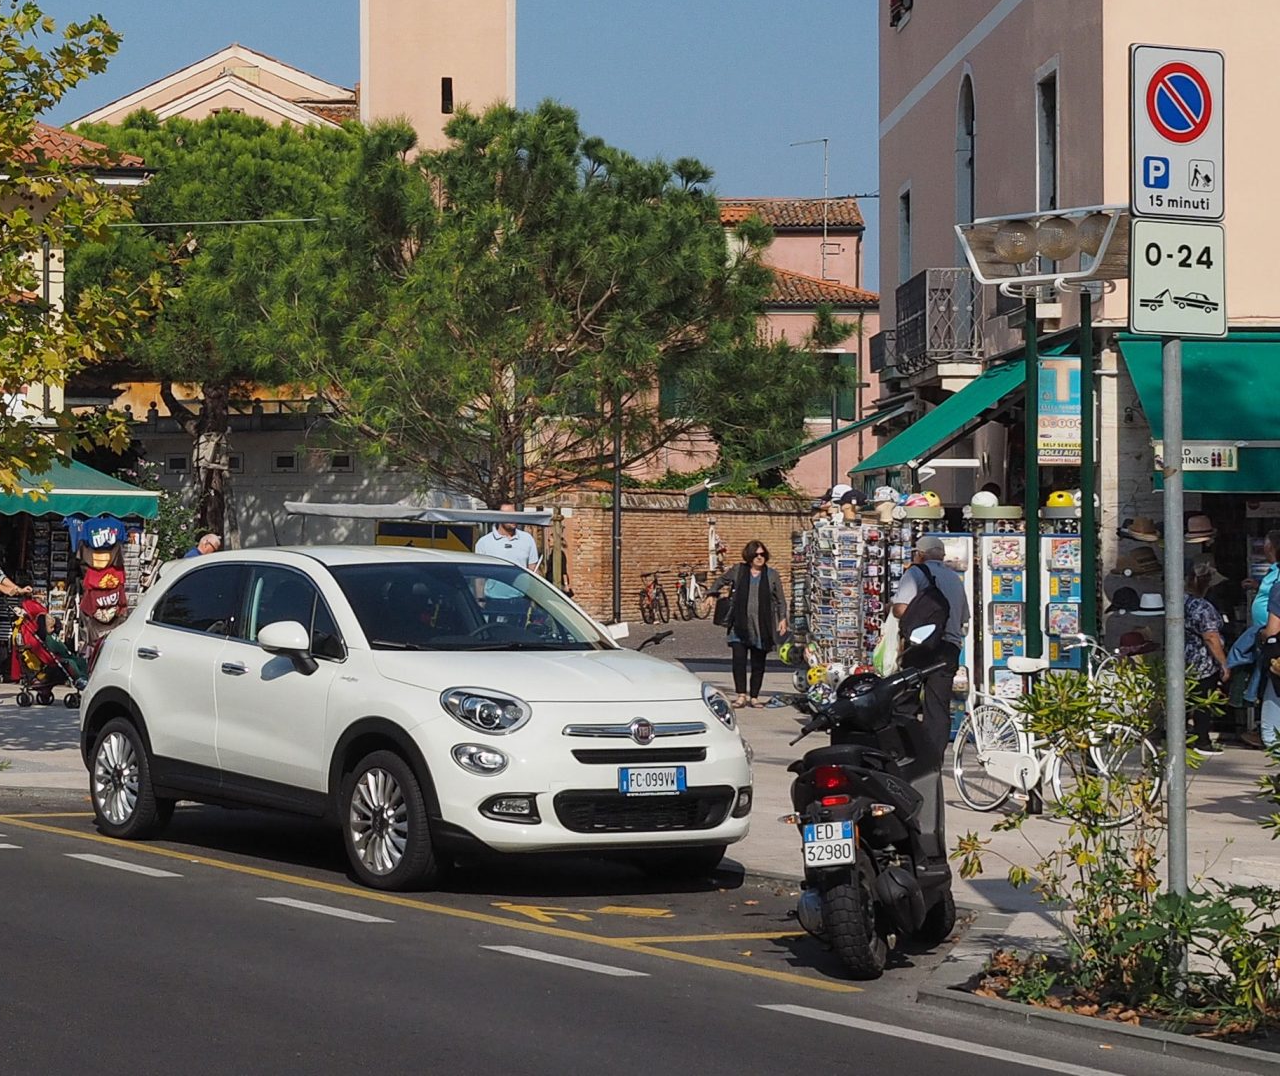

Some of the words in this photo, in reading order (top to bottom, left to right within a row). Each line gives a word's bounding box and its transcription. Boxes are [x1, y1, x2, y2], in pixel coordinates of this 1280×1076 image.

[1149, 160, 1166, 185] P
[1149, 194, 1163, 207] 15
[1167, 195, 1210, 211] minuti
[1181, 456, 1209, 464] RINKS
[816, 824, 834, 840] ED
[807, 843, 851, 862] 32980
